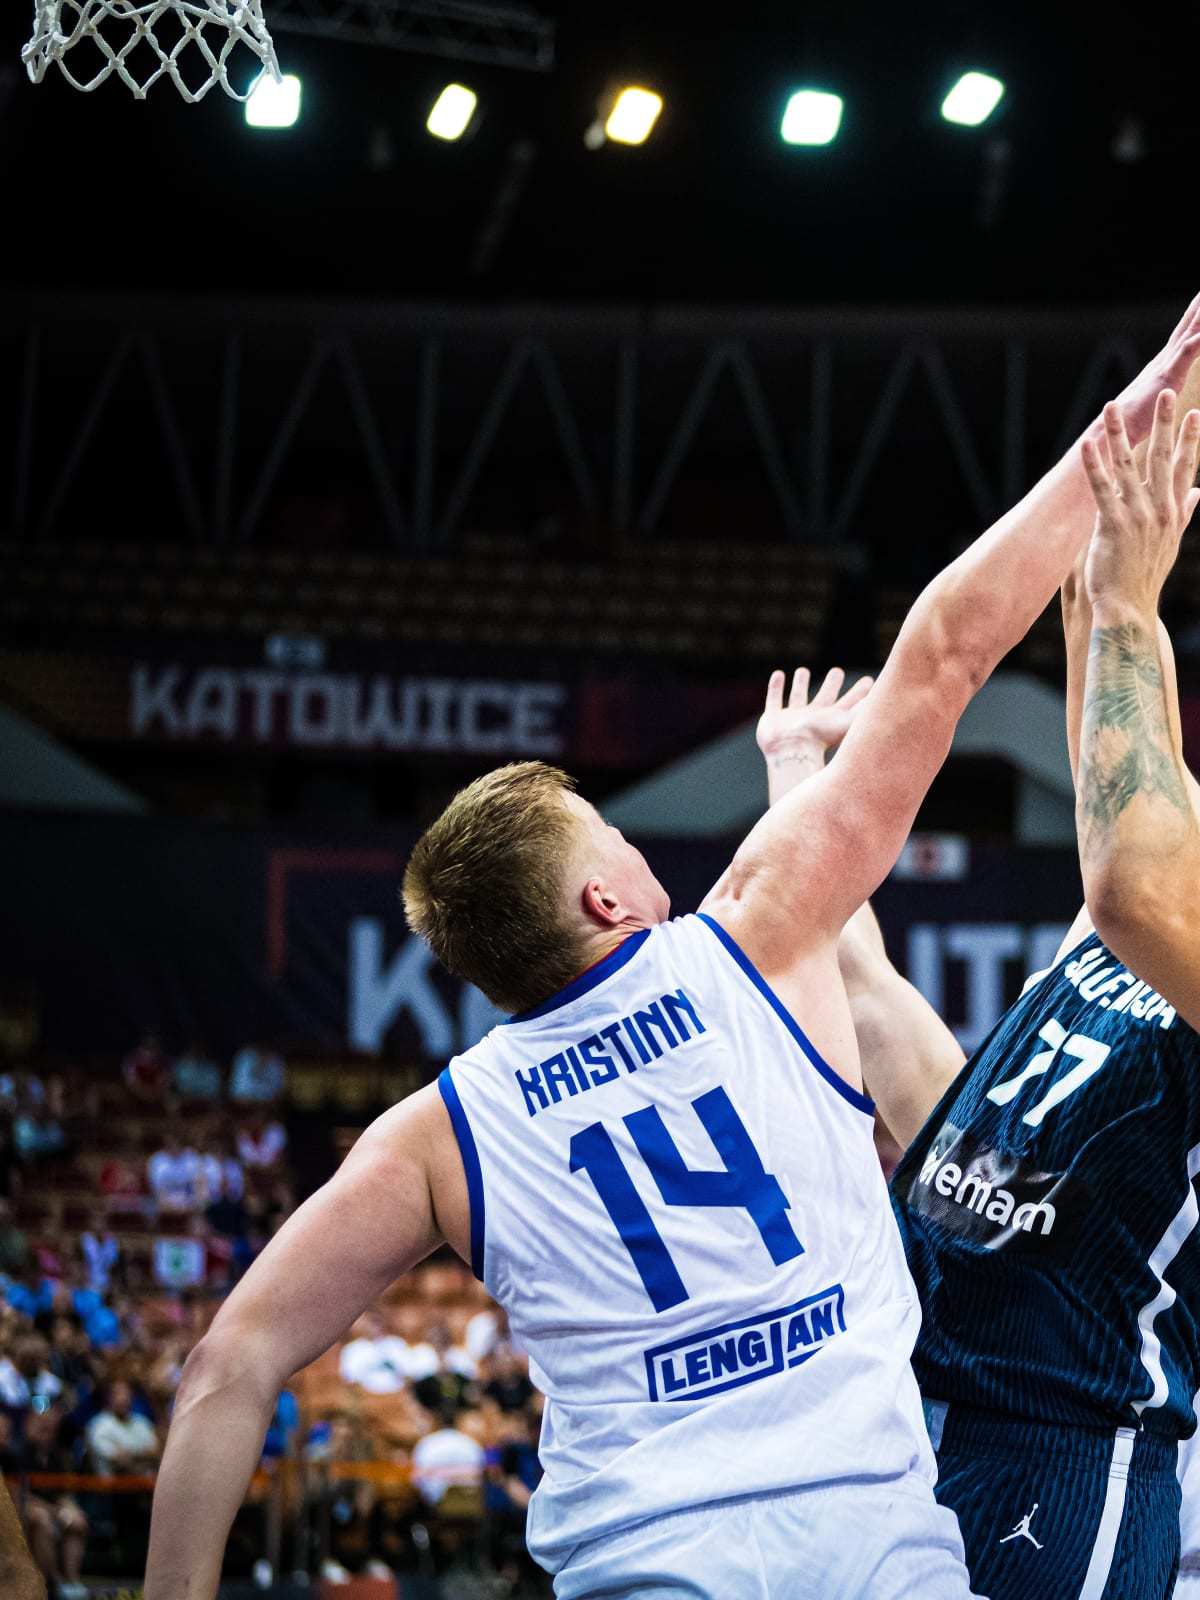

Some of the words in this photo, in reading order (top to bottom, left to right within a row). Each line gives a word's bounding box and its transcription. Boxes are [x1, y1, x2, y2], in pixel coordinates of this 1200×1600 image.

[131, 664, 566, 753] KATOWICE
[515, 988, 706, 1118] KRISTINN
[569, 1085, 805, 1314] 14
[660, 1301, 836, 1394] LENGJAN
